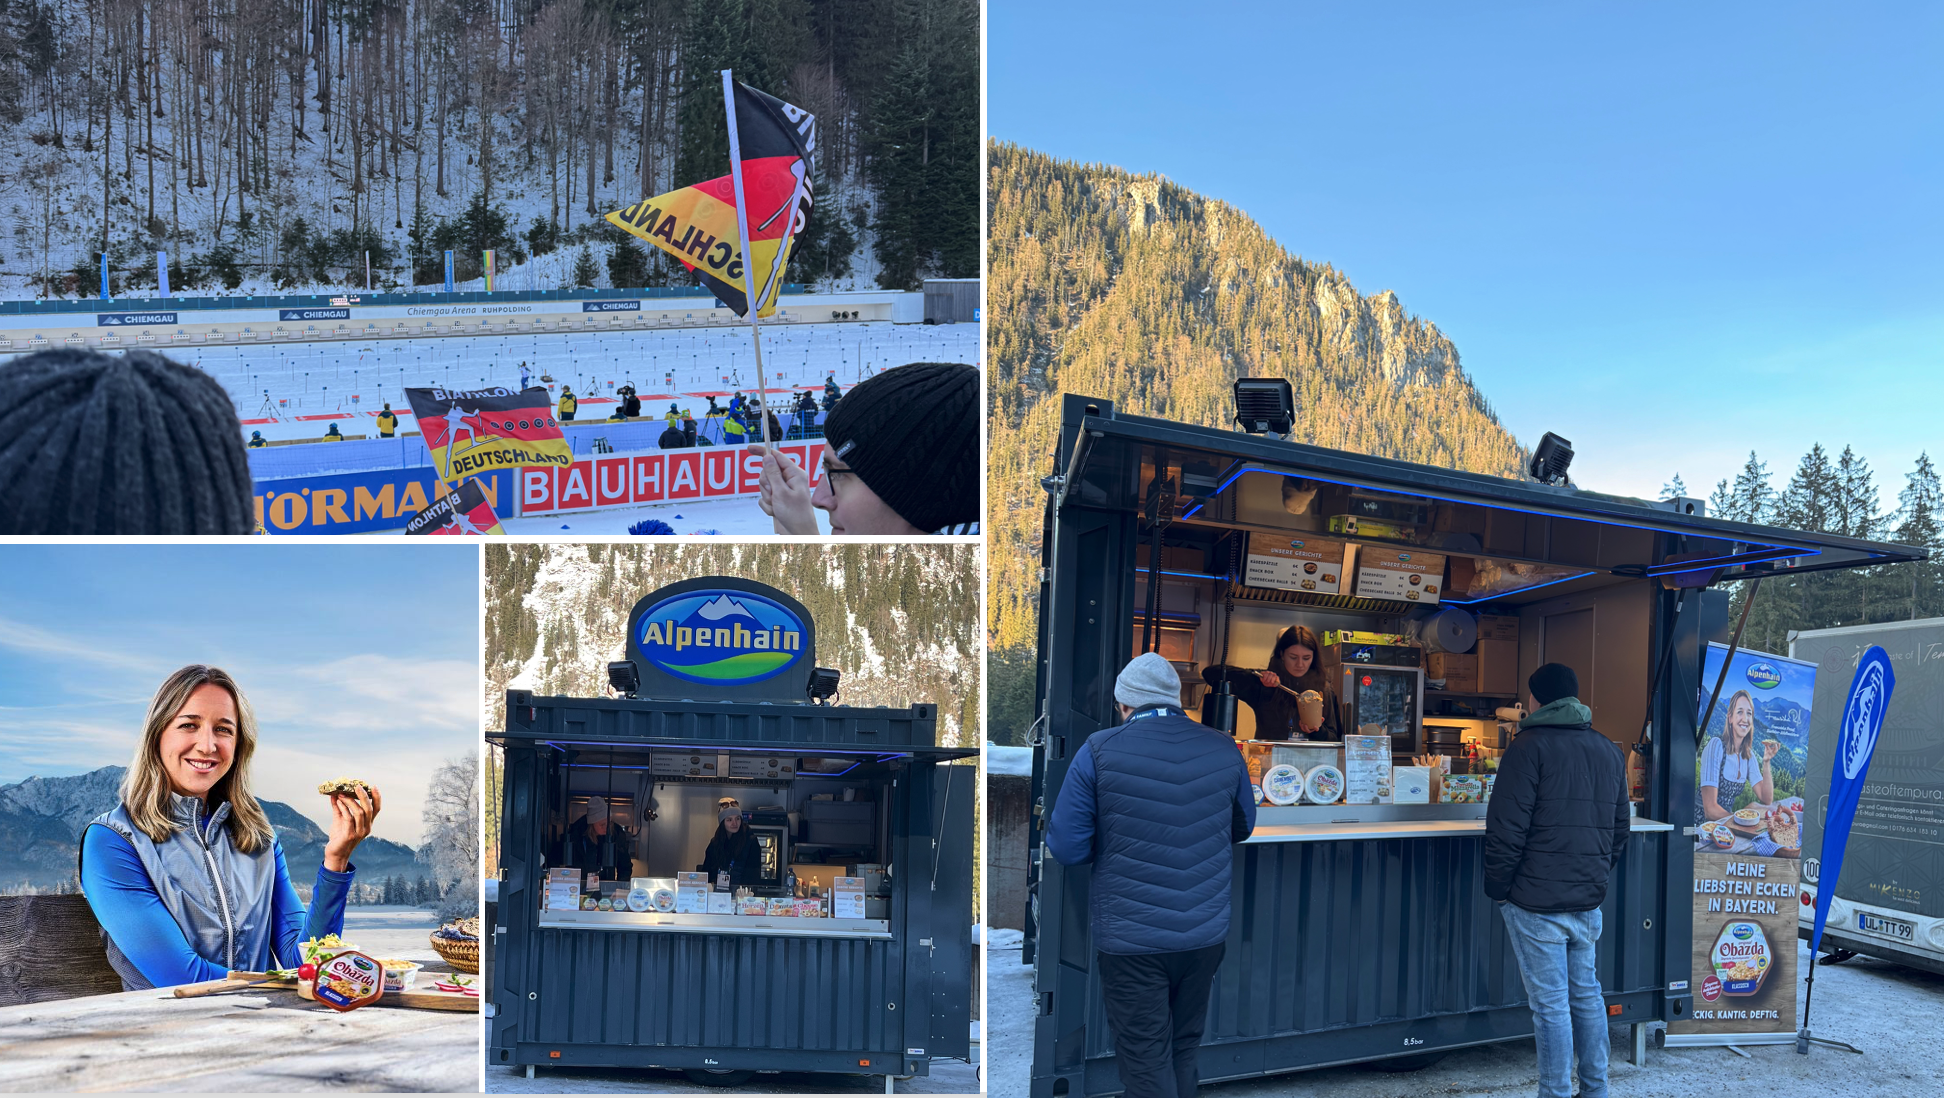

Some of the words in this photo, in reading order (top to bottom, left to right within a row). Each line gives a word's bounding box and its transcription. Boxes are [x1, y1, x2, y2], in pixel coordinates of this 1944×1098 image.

[407, 307, 450, 317] Chiemgau
[452, 306, 477, 315] Arena
[482, 306, 532, 314] RUHPOLDING
[602, 302, 638, 310] CHIEMGAU
[124, 315, 174, 324] CHIEMGAU
[303, 310, 347, 319] CHIEMGAU
[452, 449, 569, 475] DEUTSCHLAND
[1270, 547, 1293, 555] UNSERE
[1294, 550, 1322, 559] GERICHTE
[641, 619, 800, 652] Alpenhain
[1905, 650, 1914, 660] of
[1747, 669, 1781, 682] Alpenhain
[1861, 783, 1944, 800] asteoftempura.
[1725, 861, 1766, 878] MEINE
[1694, 879, 1752, 895] LIEBSTEN
[1756, 882, 1796, 897] ECKEN
[1708, 898, 1721, 912] IN
[1725, 898, 1779, 915] BAYERN.
[1865, 917, 1878, 931] UL
[1884, 921, 1897, 934] TT
[1898, 924, 1911, 937] 99
[1720, 941, 1764, 957] Obazda
[333, 961, 375, 987] Obazda
[1717, 1010, 1748, 1019] KANTIG.
[1750, 1010, 1779, 1019] DEFTIG.
